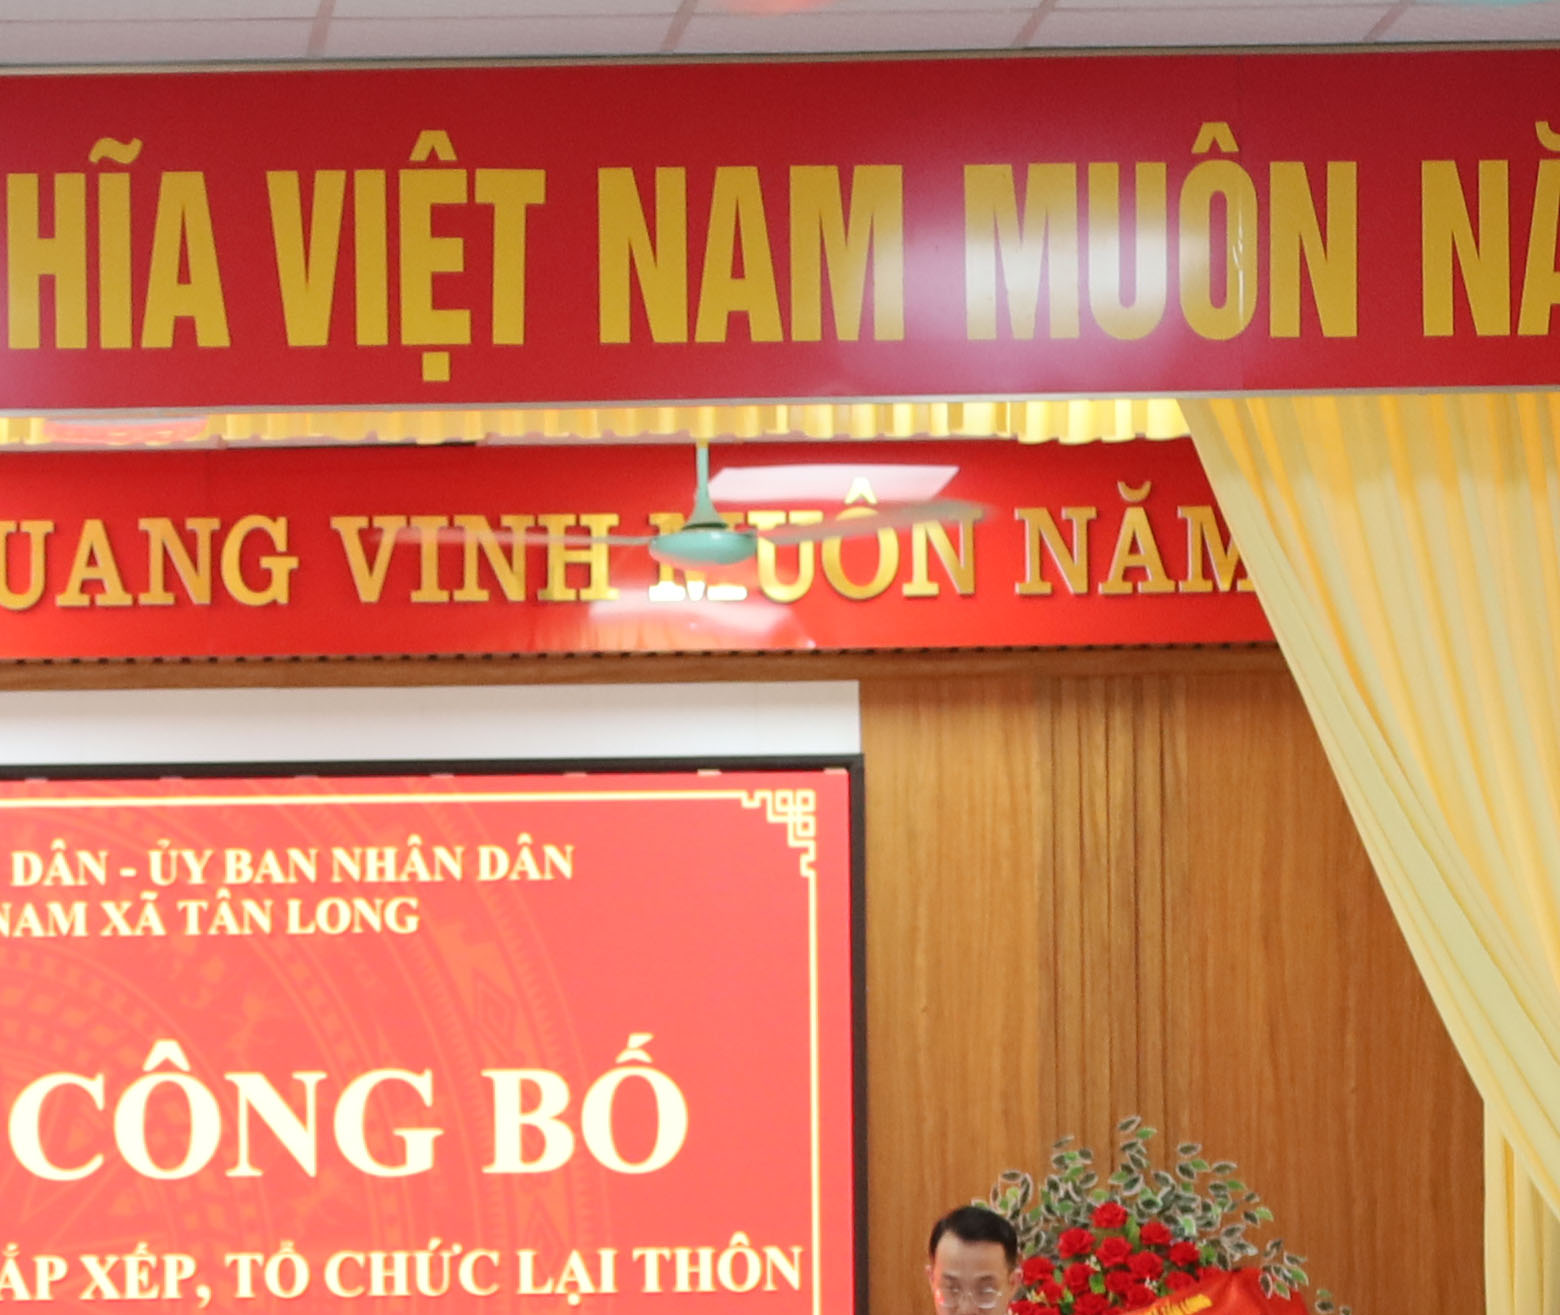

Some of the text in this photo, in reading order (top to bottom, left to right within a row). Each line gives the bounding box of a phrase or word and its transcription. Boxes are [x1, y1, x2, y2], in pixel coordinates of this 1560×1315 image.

[267, 131, 545, 382] VIỆT
[599, 165, 913, 352] NAM
[956, 123, 1357, 349] MUÔN
[334, 512, 620, 604] VINH
[12, 838, 107, 886] DÂN
[148, 839, 213, 885] ỦY
[224, 848, 318, 884] BAN
[332, 834, 464, 882] NHÂN
[477, 833, 573, 881] DÂN
[101, 891, 166, 936] XÃ
[177, 887, 272, 935] TÂN
[287, 897, 419, 934] LONG
[8, 1039, 443, 1181] CÔNG
[482, 1033, 688, 1173] BỐ
[80, 1242, 211, 1307] XẾP,
[225, 1240, 309, 1298] TỔ
[325, 1238, 499, 1297] CHỨC
[517, 1248, 617, 1305] LẠI
[633, 1232, 802, 1292] THÔN
